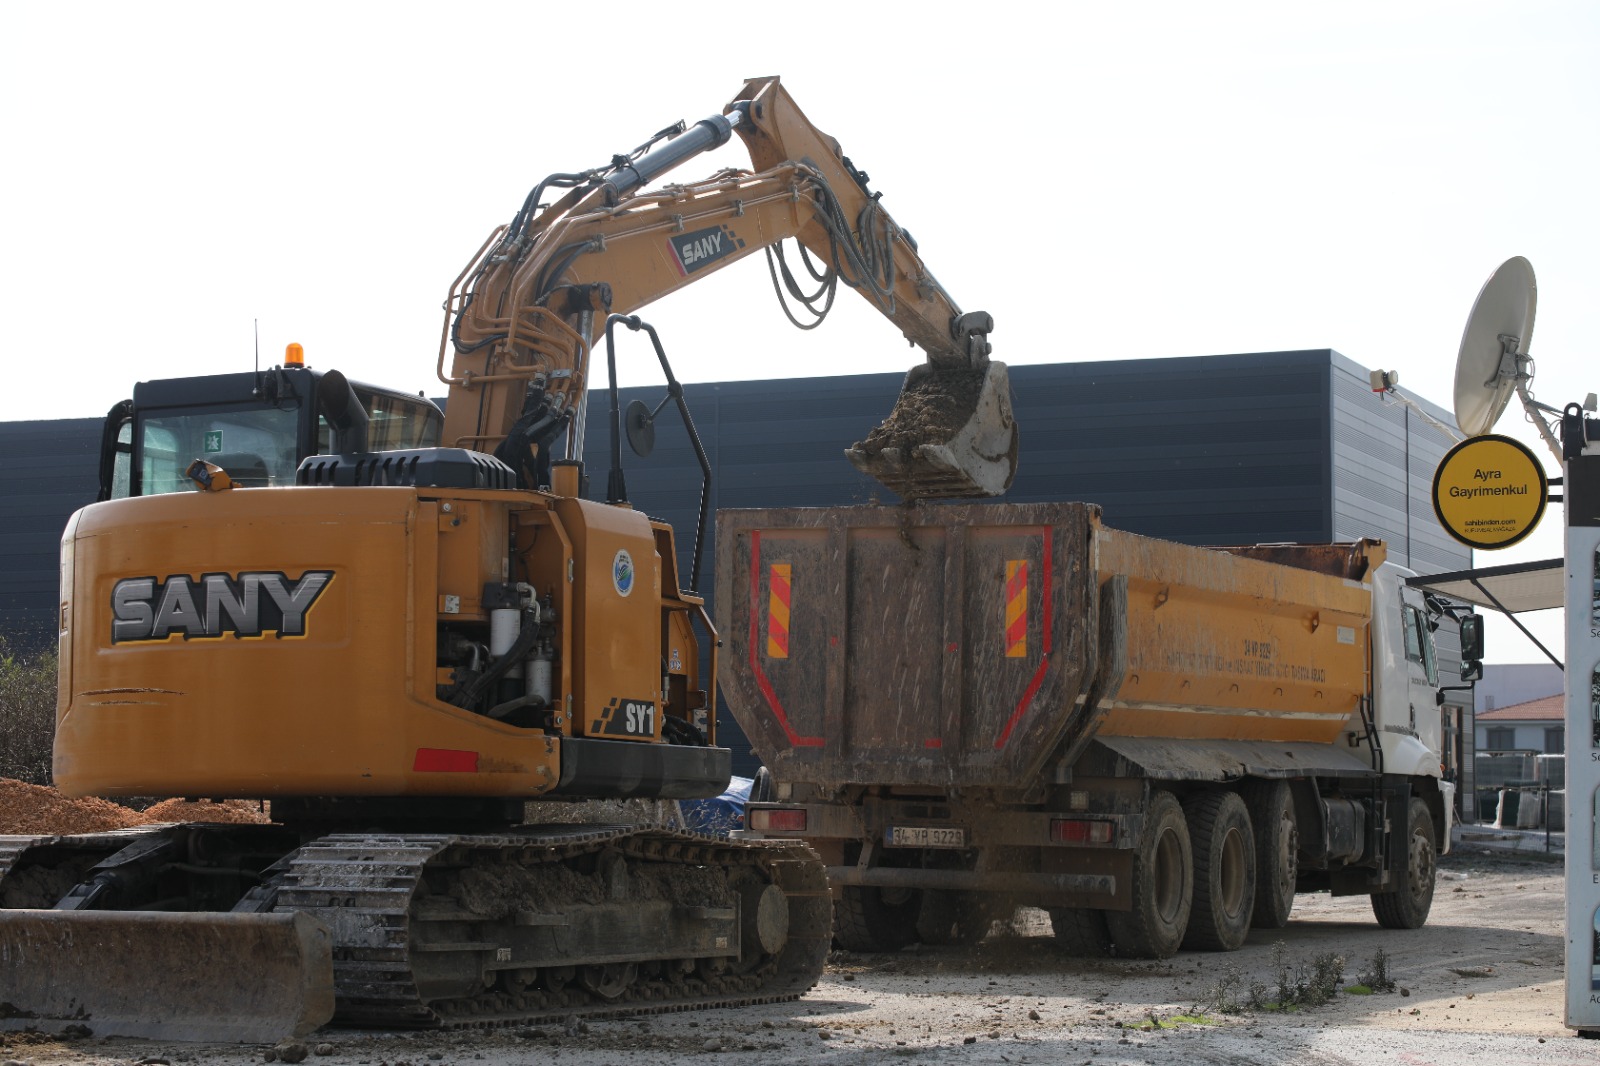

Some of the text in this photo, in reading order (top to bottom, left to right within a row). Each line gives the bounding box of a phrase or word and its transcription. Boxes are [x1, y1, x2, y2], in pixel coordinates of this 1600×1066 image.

[682, 231, 722, 266] SANY
[1473, 468, 1502, 482] Ayra
[1449, 484, 1528, 500] Gayrimenkul
[112, 571, 335, 644] SANY
[625, 702, 654, 735] SY1
[894, 828, 910, 843] 34
[933, 830, 962, 845] 9229
